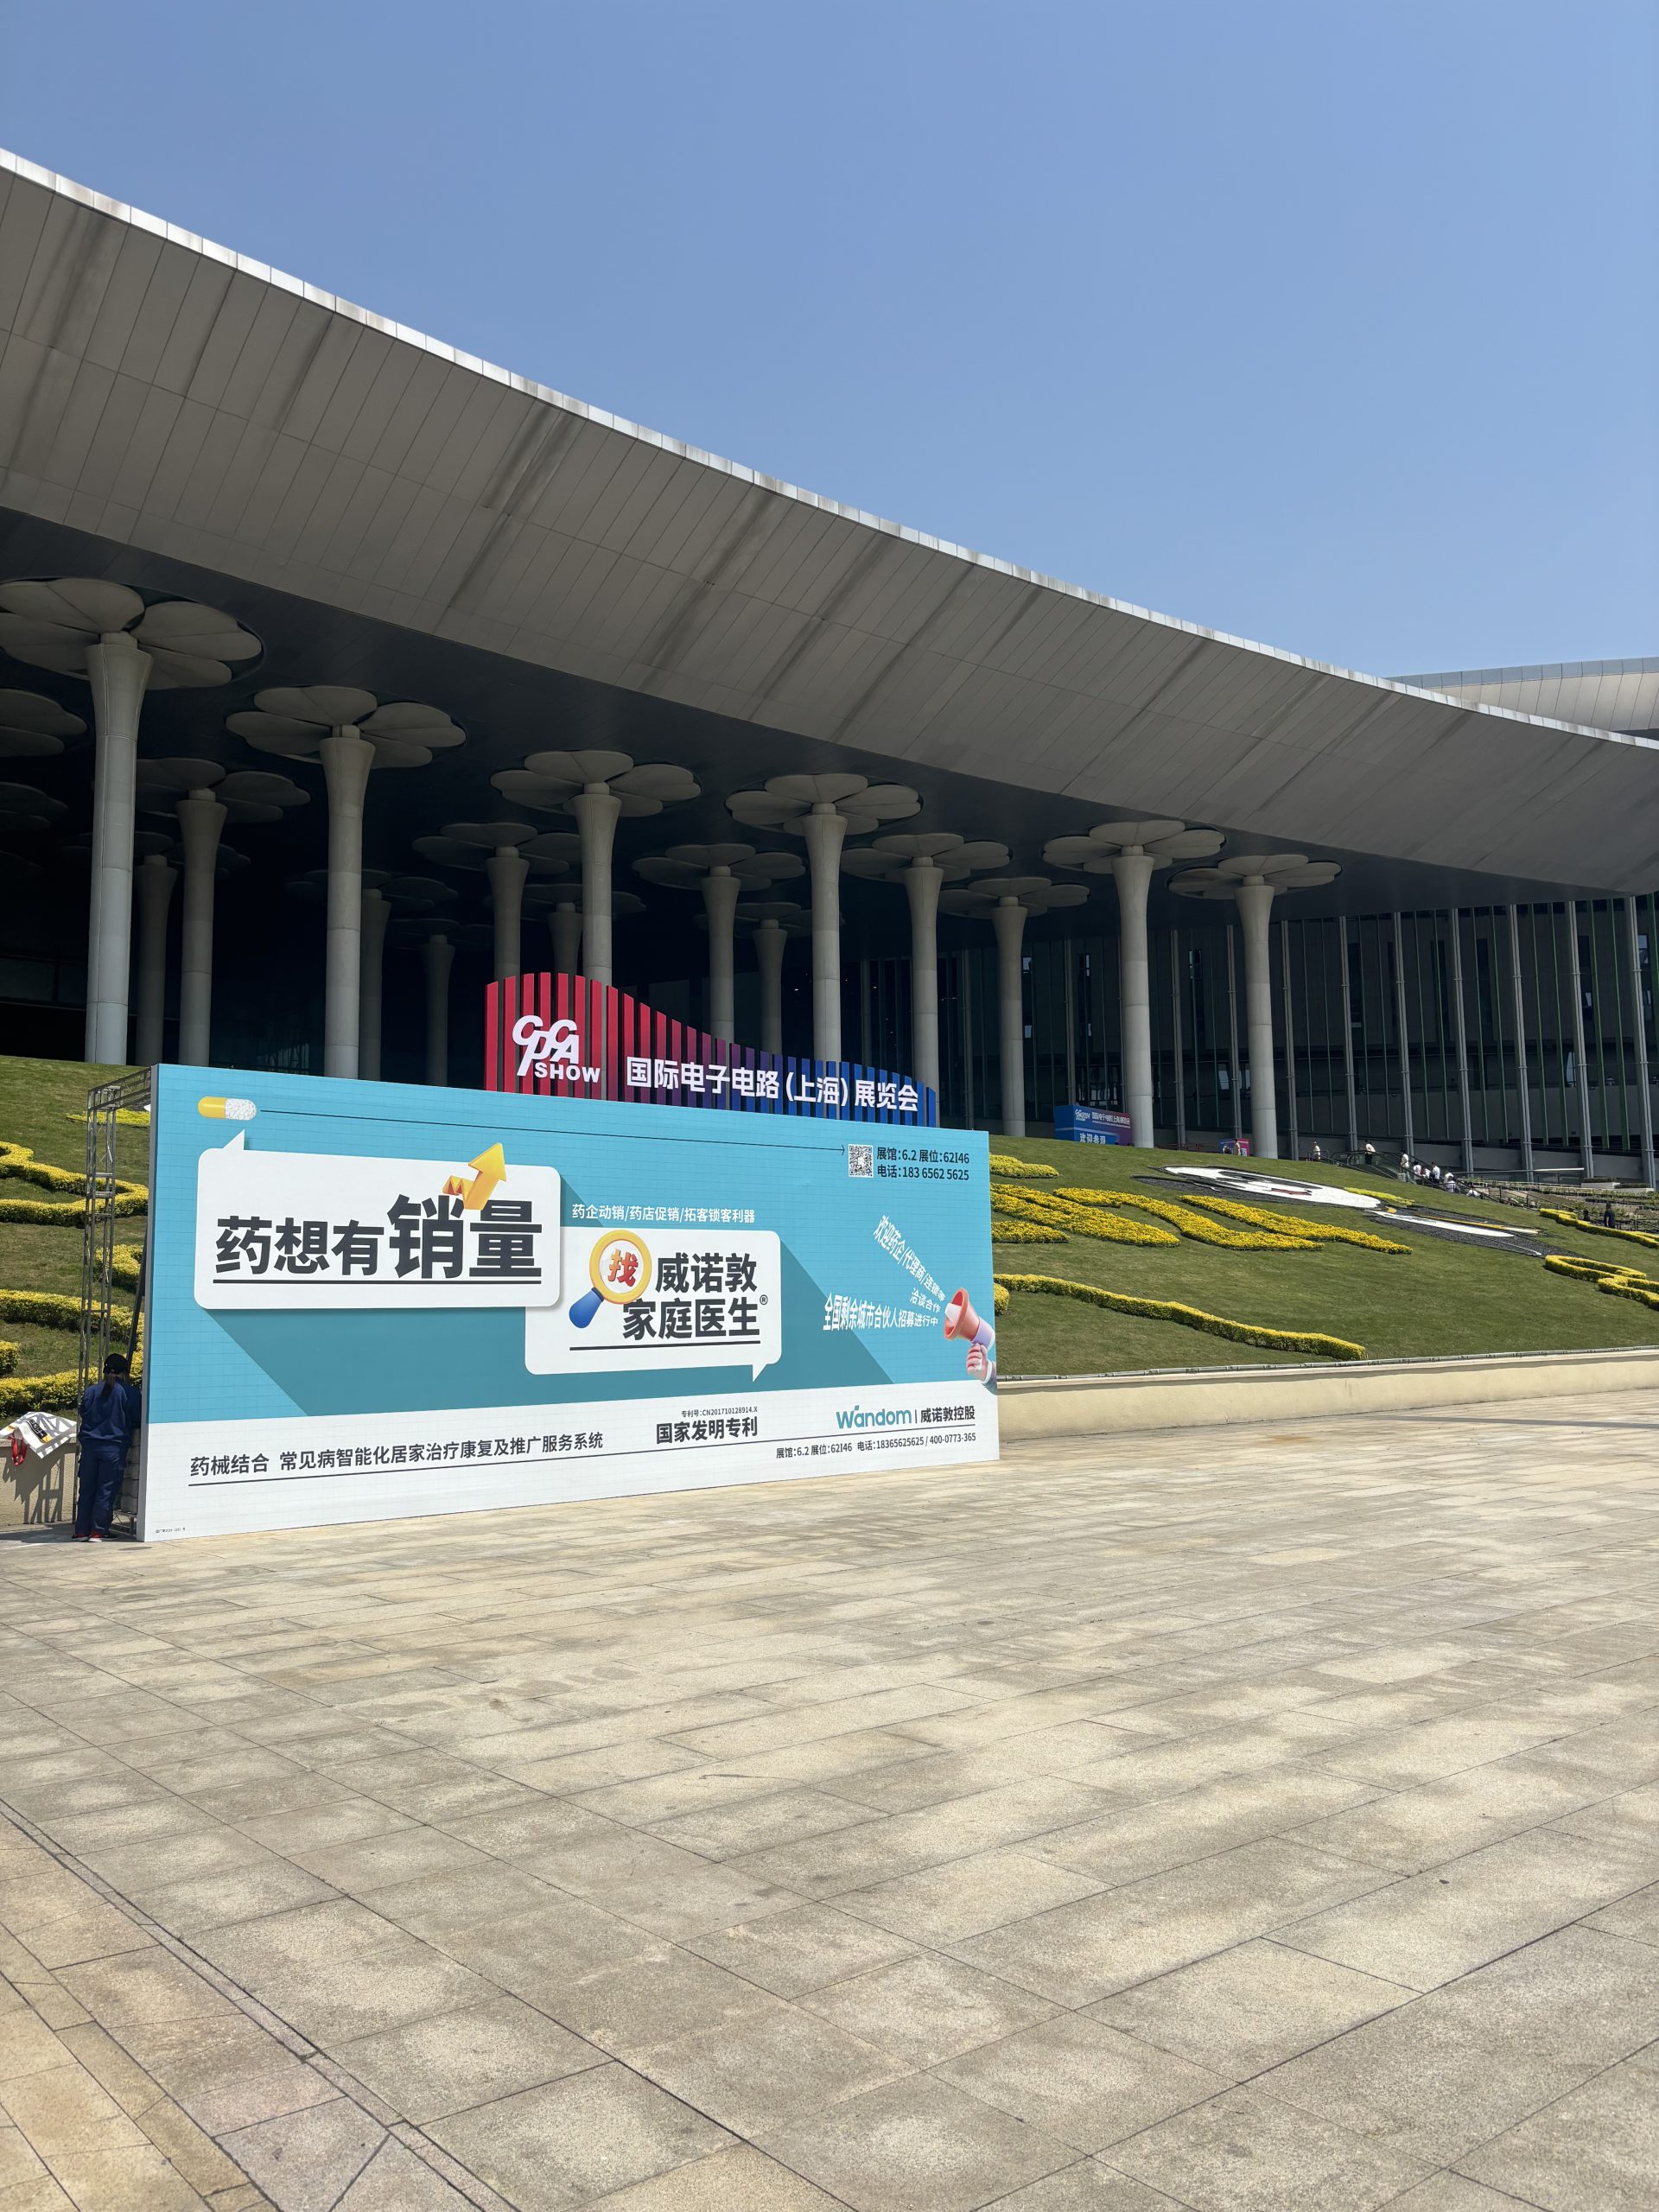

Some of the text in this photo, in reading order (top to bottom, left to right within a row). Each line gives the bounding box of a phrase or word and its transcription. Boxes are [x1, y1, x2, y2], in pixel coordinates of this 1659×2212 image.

[534, 1062, 601, 1083] SHOW
[626, 1057, 918, 1112] 国际电子电路（上海）展览会
[922, 1167, 944, 1179] 6562
[946, 1169, 969, 1180] 5625
[572, 1204, 755, 1224] 药企动销/药店促销/拓客锁客利器
[215, 1194, 542, 1279] 药想有销量
[607, 1249, 639, 1287] 找
[655, 1252, 757, 1294] 威诺敦
[910, 1287, 942, 1313] 洽谈合作
[836, 1405, 912, 1429] Wandom
[920, 1406, 976, 1423] 威诺敦控股
[656, 1416, 758, 1445] 国家发明专利
[930, 1433, 976, 1445] 400-0773-365
[189, 1431, 603, 1477] 药械结合 常见病智能化居家治疗康复及推广服务系统
